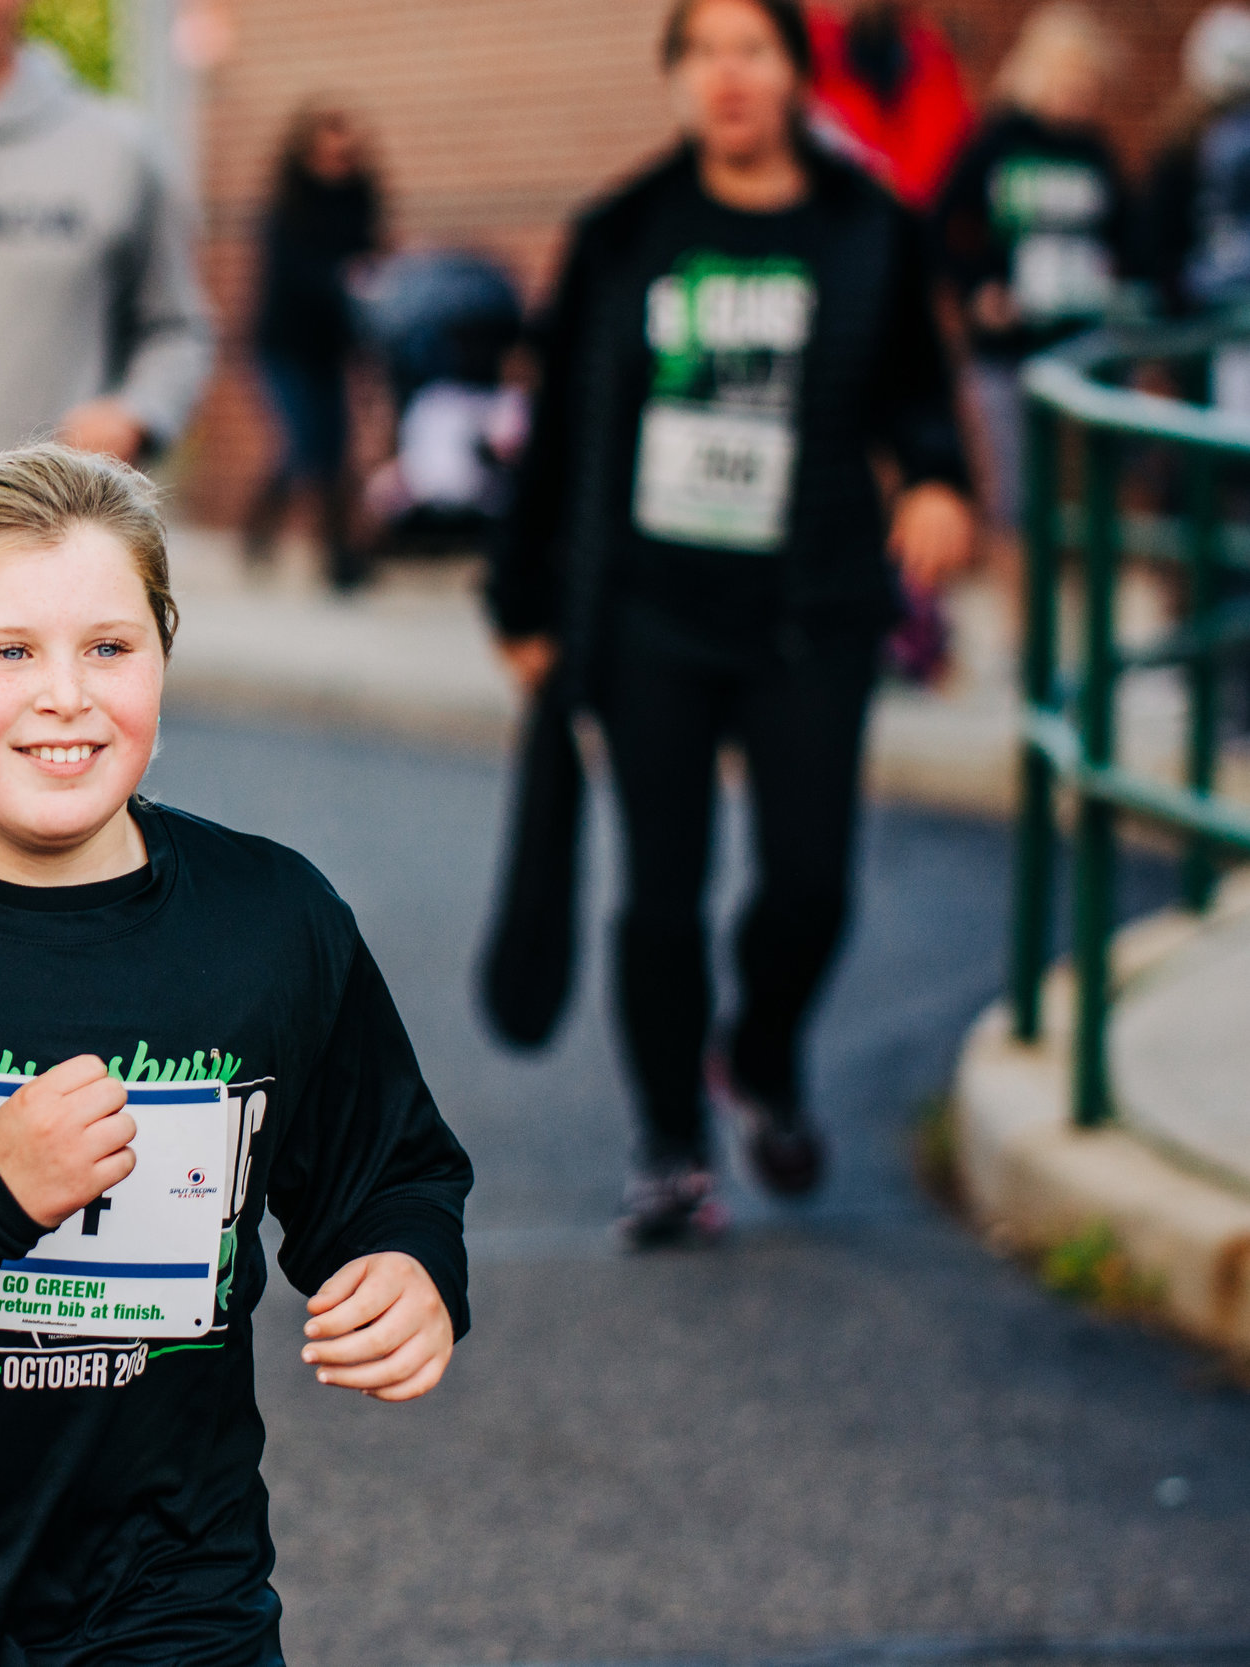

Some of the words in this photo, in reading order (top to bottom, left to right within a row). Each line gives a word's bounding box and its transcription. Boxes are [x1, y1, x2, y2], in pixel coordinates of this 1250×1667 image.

[2, 1275, 29, 1294] GO
[35, 1278, 106, 1299] GREEN!
[57, 1301, 86, 1318] bib
[90, 1303, 108, 1319] at
[113, 1304, 165, 1321] finish.
[3, 1352, 109, 1389] OCTOBER
